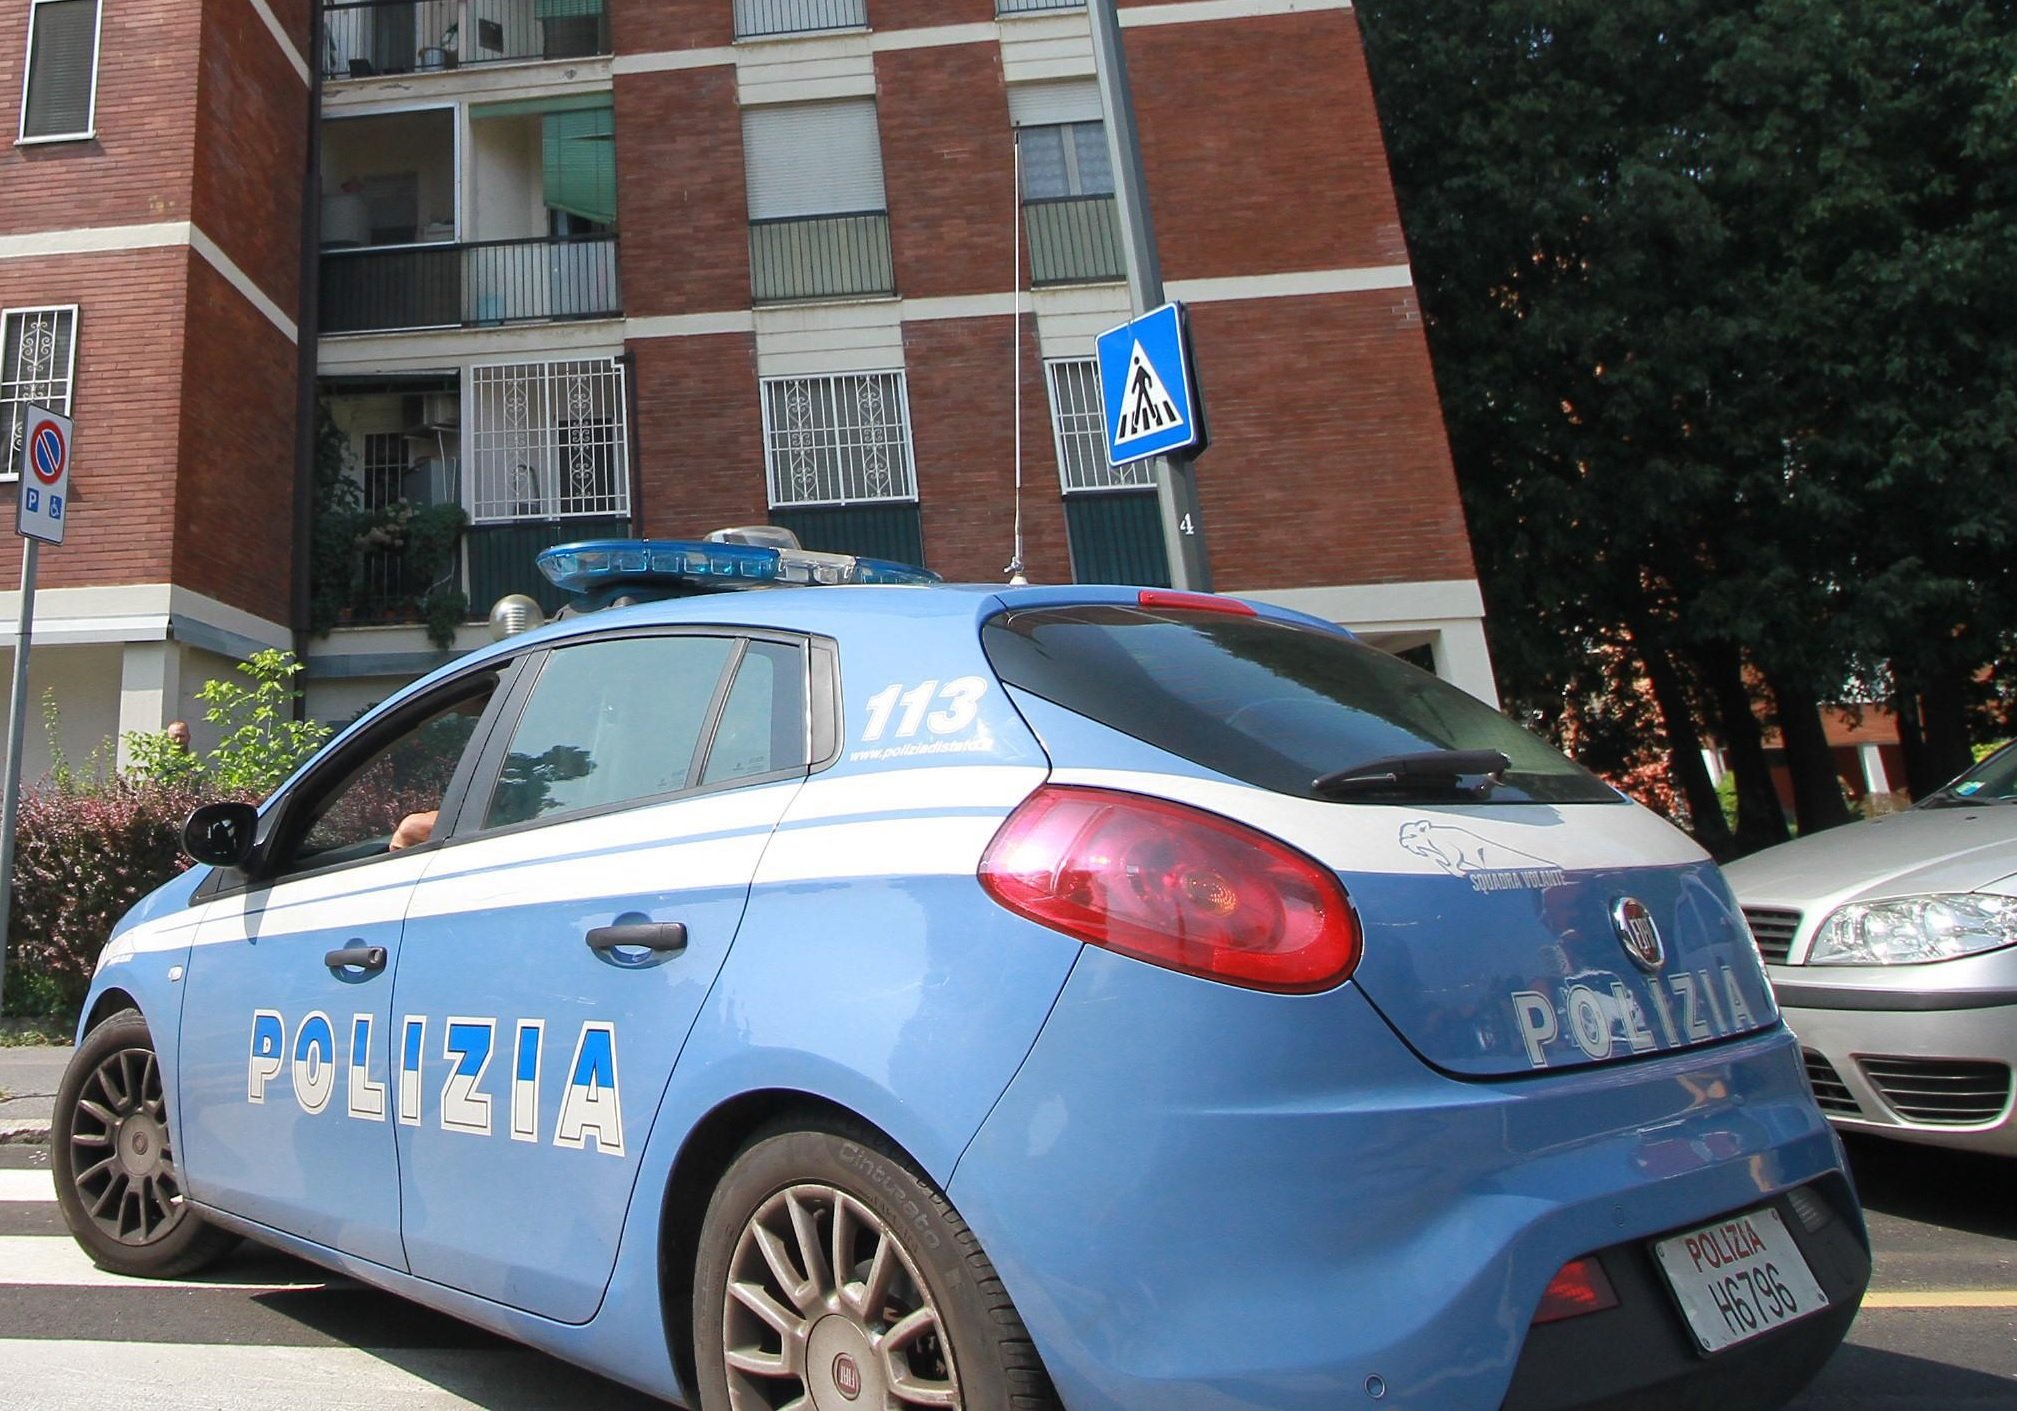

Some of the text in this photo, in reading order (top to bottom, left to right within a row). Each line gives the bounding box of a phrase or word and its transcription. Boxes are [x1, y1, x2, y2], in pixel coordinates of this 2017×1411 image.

[28, 492, 37, 508] P
[1180, 513, 1194, 535] 4
[861, 676, 988, 742] 113
[1469, 869, 1567, 895] SQUADRA VOLANTE
[1511, 965, 1757, 1068] POLIZIA
[247, 1008, 626, 1157] POLIZIA
[841, 1141, 941, 1249] Cinturato
[1684, 1219, 1767, 1273] POLIZIA
[1707, 1262, 1798, 1336] H6796
